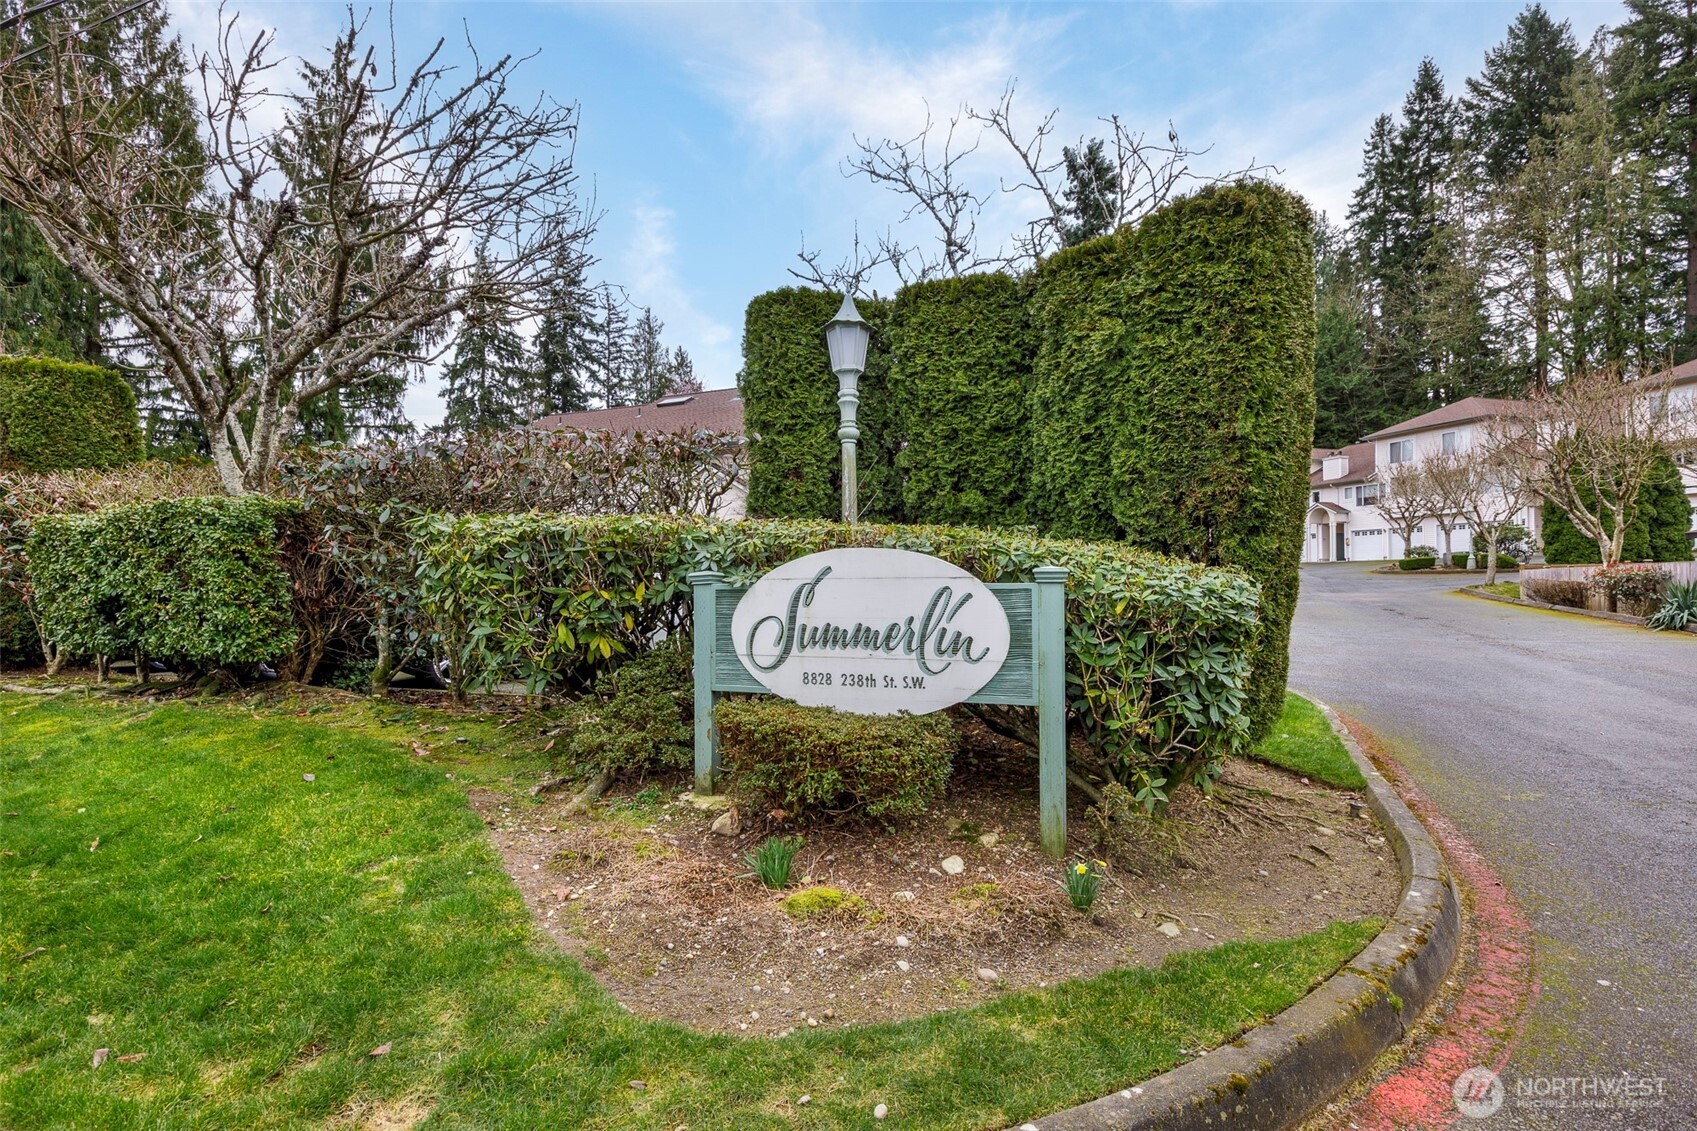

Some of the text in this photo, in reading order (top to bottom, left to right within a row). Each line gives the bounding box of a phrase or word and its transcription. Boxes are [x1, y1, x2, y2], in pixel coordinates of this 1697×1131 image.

[746, 565, 990, 676] Summerlin
[802, 671, 926, 690] 8828 238th St. S.W.
